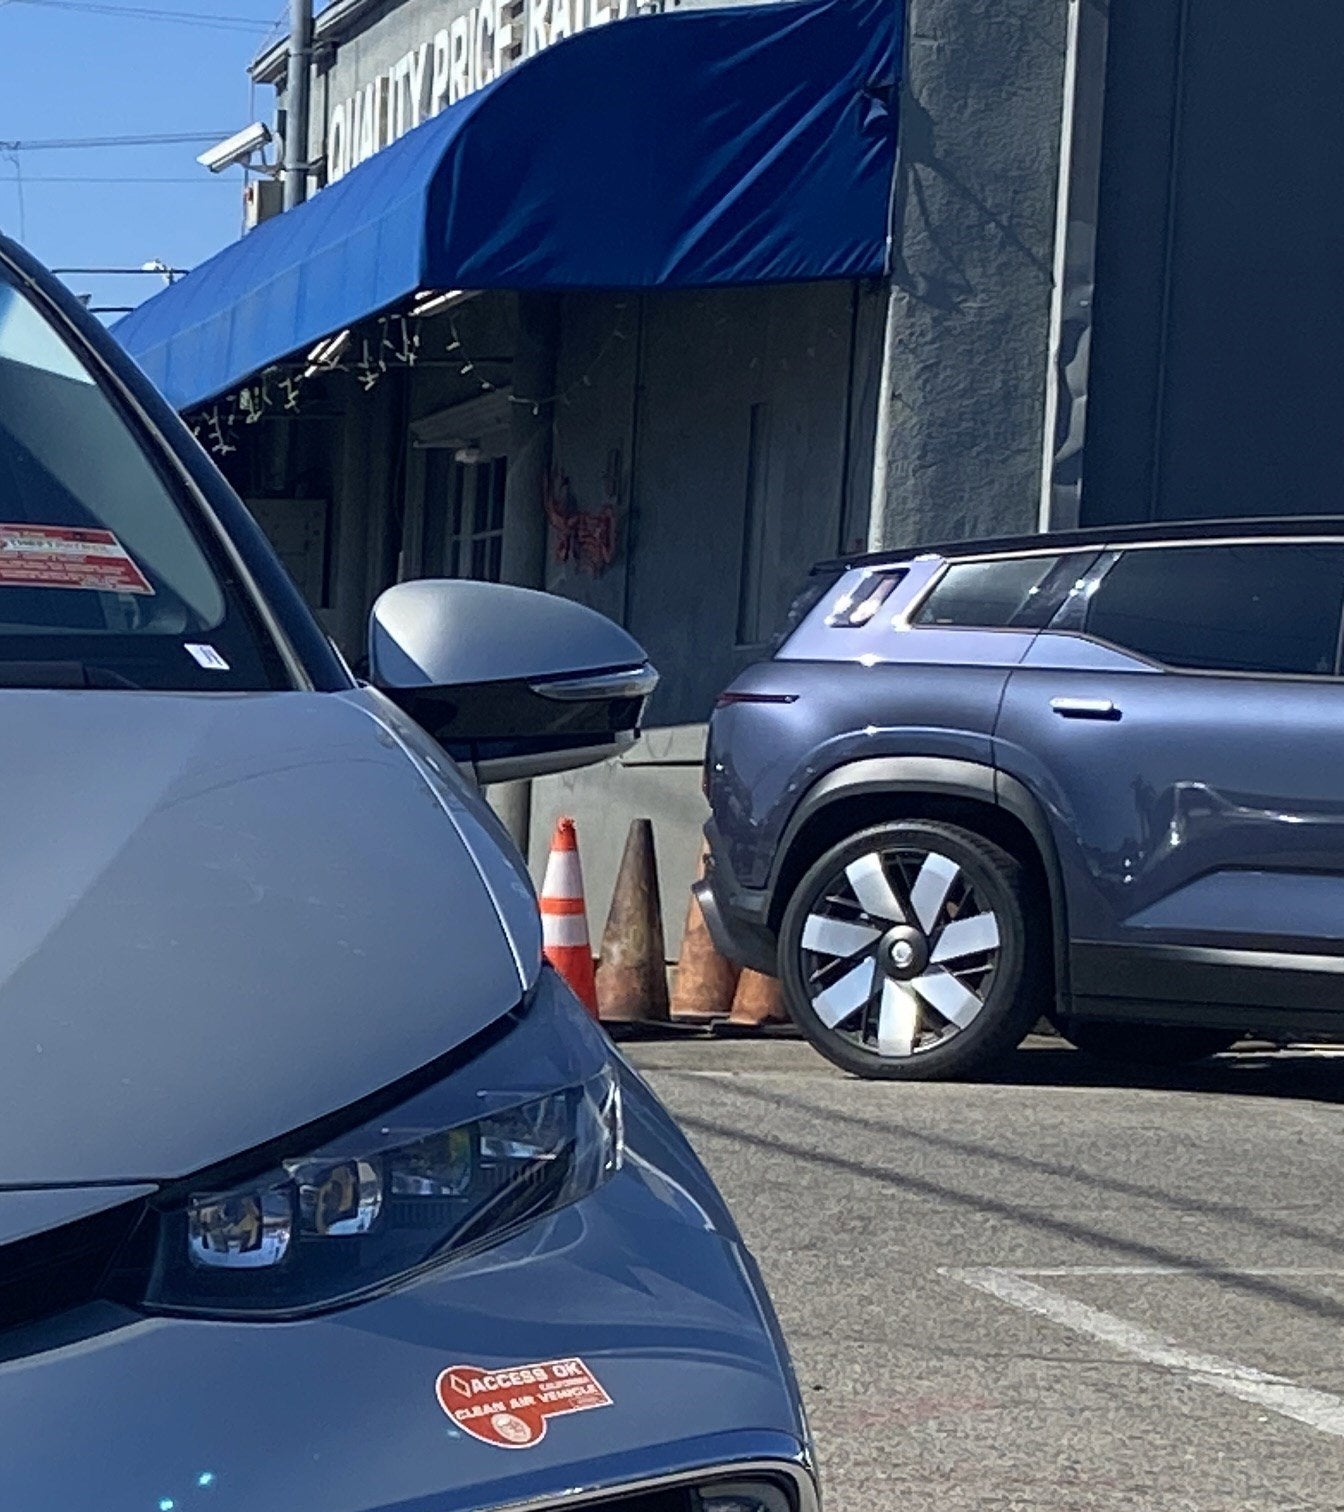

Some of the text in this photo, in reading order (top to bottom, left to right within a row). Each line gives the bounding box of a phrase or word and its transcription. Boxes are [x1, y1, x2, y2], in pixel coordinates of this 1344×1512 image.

[327, 42, 434, 186] QUALITY
[431, 0, 516, 118] PRICE
[470, 1361, 583, 1394] ACCESS OK
[455, 1401, 507, 1420] CLEAN
[510, 1395, 537, 1409] AIR
[537, 1384, 599, 1403] VEHICLE
